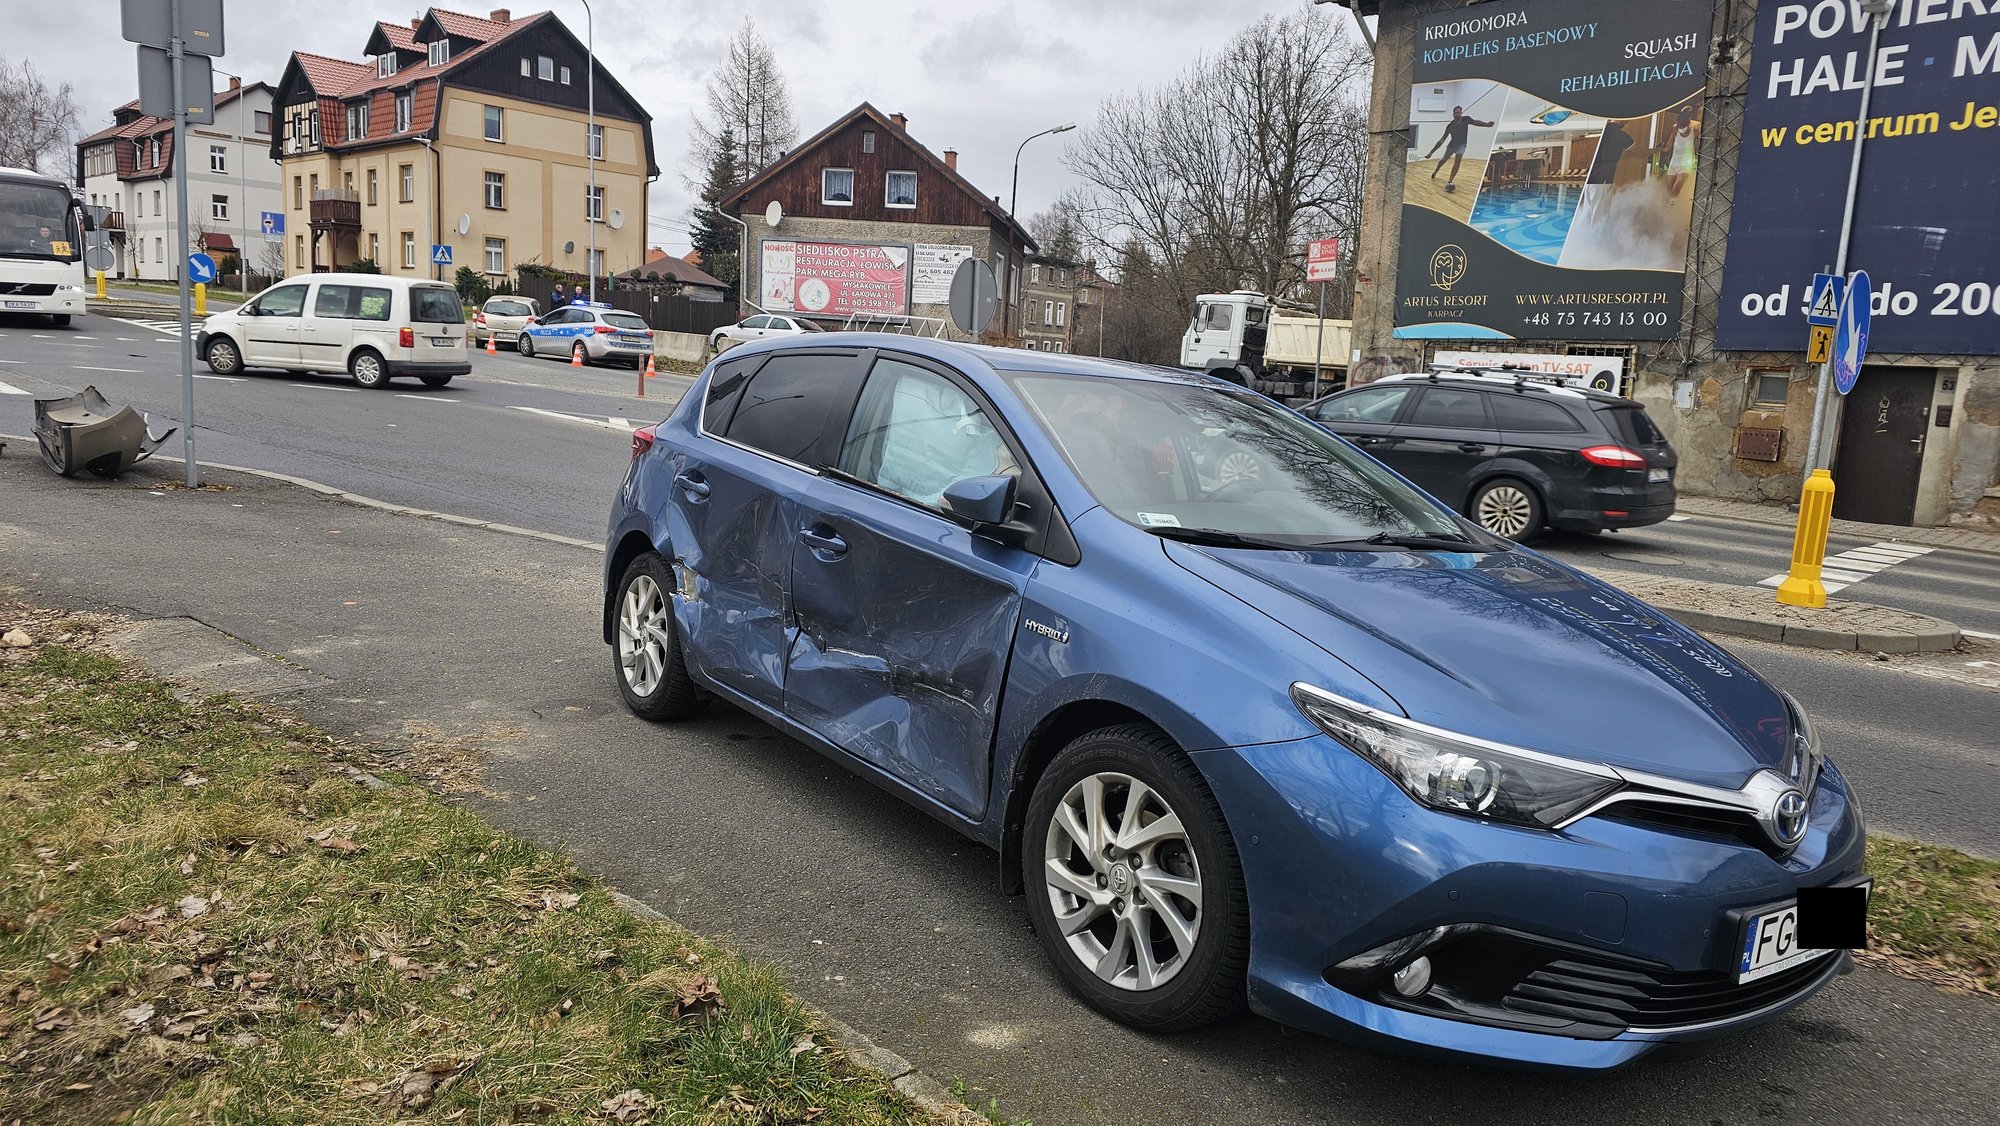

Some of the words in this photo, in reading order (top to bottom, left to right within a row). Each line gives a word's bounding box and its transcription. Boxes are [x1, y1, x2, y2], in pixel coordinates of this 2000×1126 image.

[1425, 10, 1528, 40] KRIOKOMORA
[1423, 40, 1500, 64] KOMPLEKS
[1505, 22, 1598, 52] BASENOWY
[1624, 32, 1698, 60] SQUASH
[1560, 60, 1694, 93] REHABILITACJA
[1767, 44, 1909, 99] HALE
[1761, 126, 1787, 148] w
[1795, 111, 1940, 146] centrum
[1950, 102, 2000, 132] Je
[796, 244, 850, 256] SIEDLISKO
[796, 257, 856, 268] RESTAURACJA
[796, 268, 818, 276] PARK
[820, 270, 847, 278] MEGA
[1404, 296, 1440, 307] ARTUS
[1443, 294, 1488, 306] RESORT
[1516, 292, 1669, 305] WWW.ARTUSRESORT.PL
[1740, 284, 1790, 316] od
[1870, 282, 1918, 316] do
[1931, 282, 2000, 316] 20
[1427, 309, 1465, 318] KARPACZ
[1523, 312, 1550, 326] +48
[1557, 312, 1575, 326] 75
[1583, 312, 1611, 326] 743
[1620, 312, 1634, 326] 13
[1643, 312, 1667, 326] 00
[1543, 362, 1592, 374] TV-SAT
[1942, 380, 1956, 391] 53
[1024, 618, 1061, 642] HYBRID
[1742, 952, 1750, 964] PL
